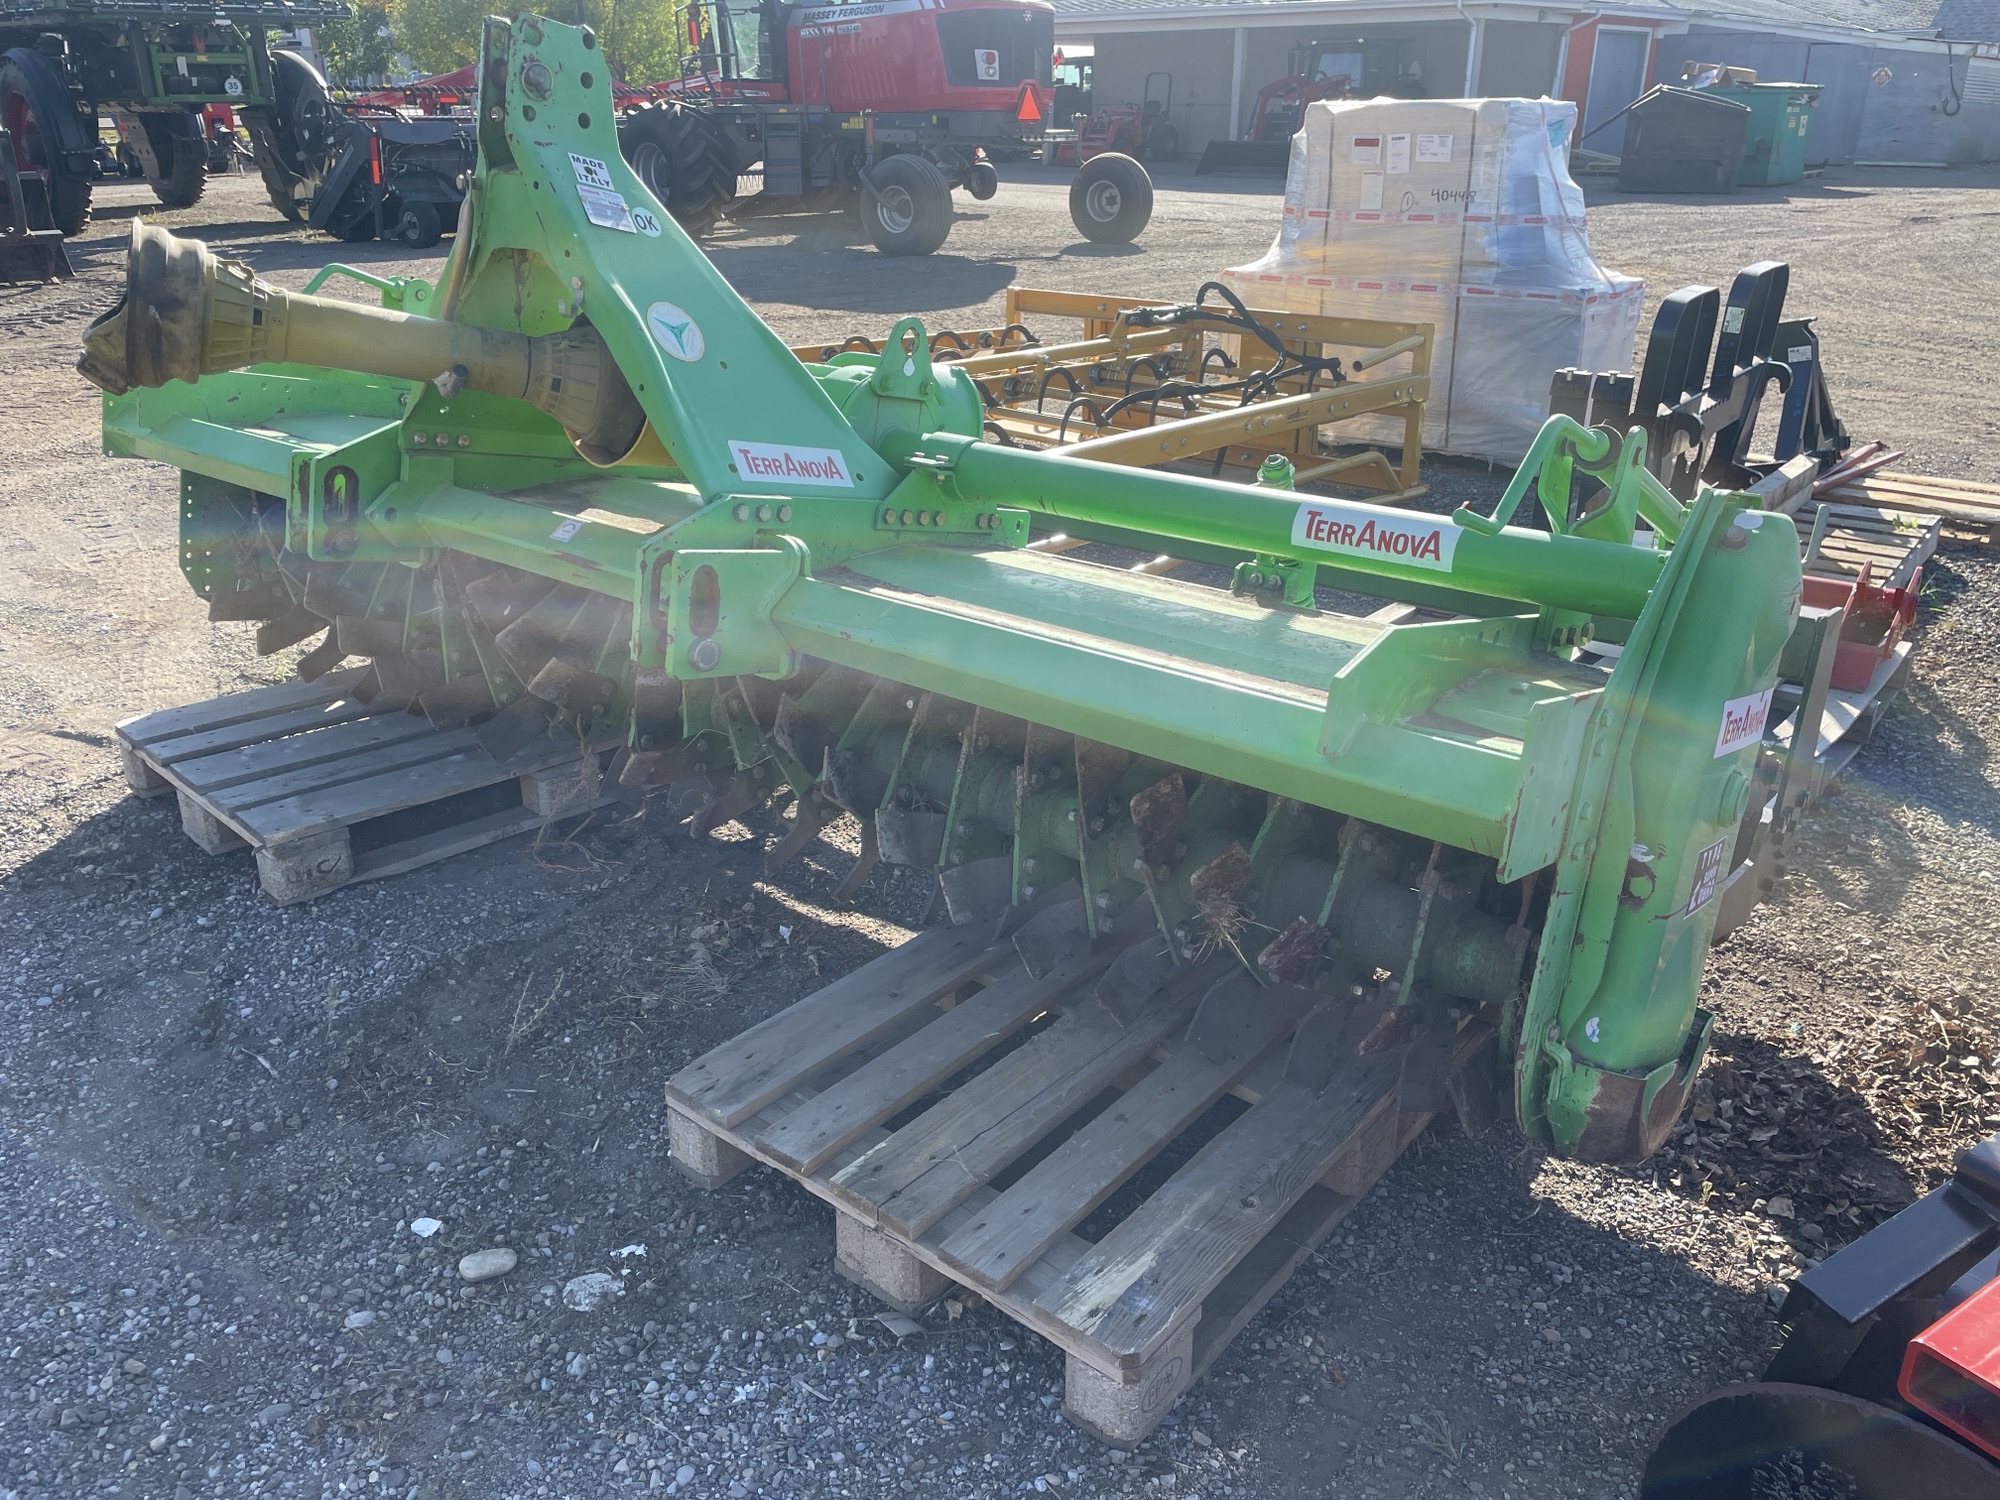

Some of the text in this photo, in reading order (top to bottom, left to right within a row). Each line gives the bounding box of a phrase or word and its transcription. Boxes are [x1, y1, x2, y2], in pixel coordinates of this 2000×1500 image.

[803, 4, 885, 20] MASSEY FERGUSON
[228, 81, 239, 90] 35
[571, 155, 605, 170] MADE
[578, 173, 610, 188] ITALY
[635, 213, 660, 232] OK
[1701, 843, 1723, 870] TYPE
